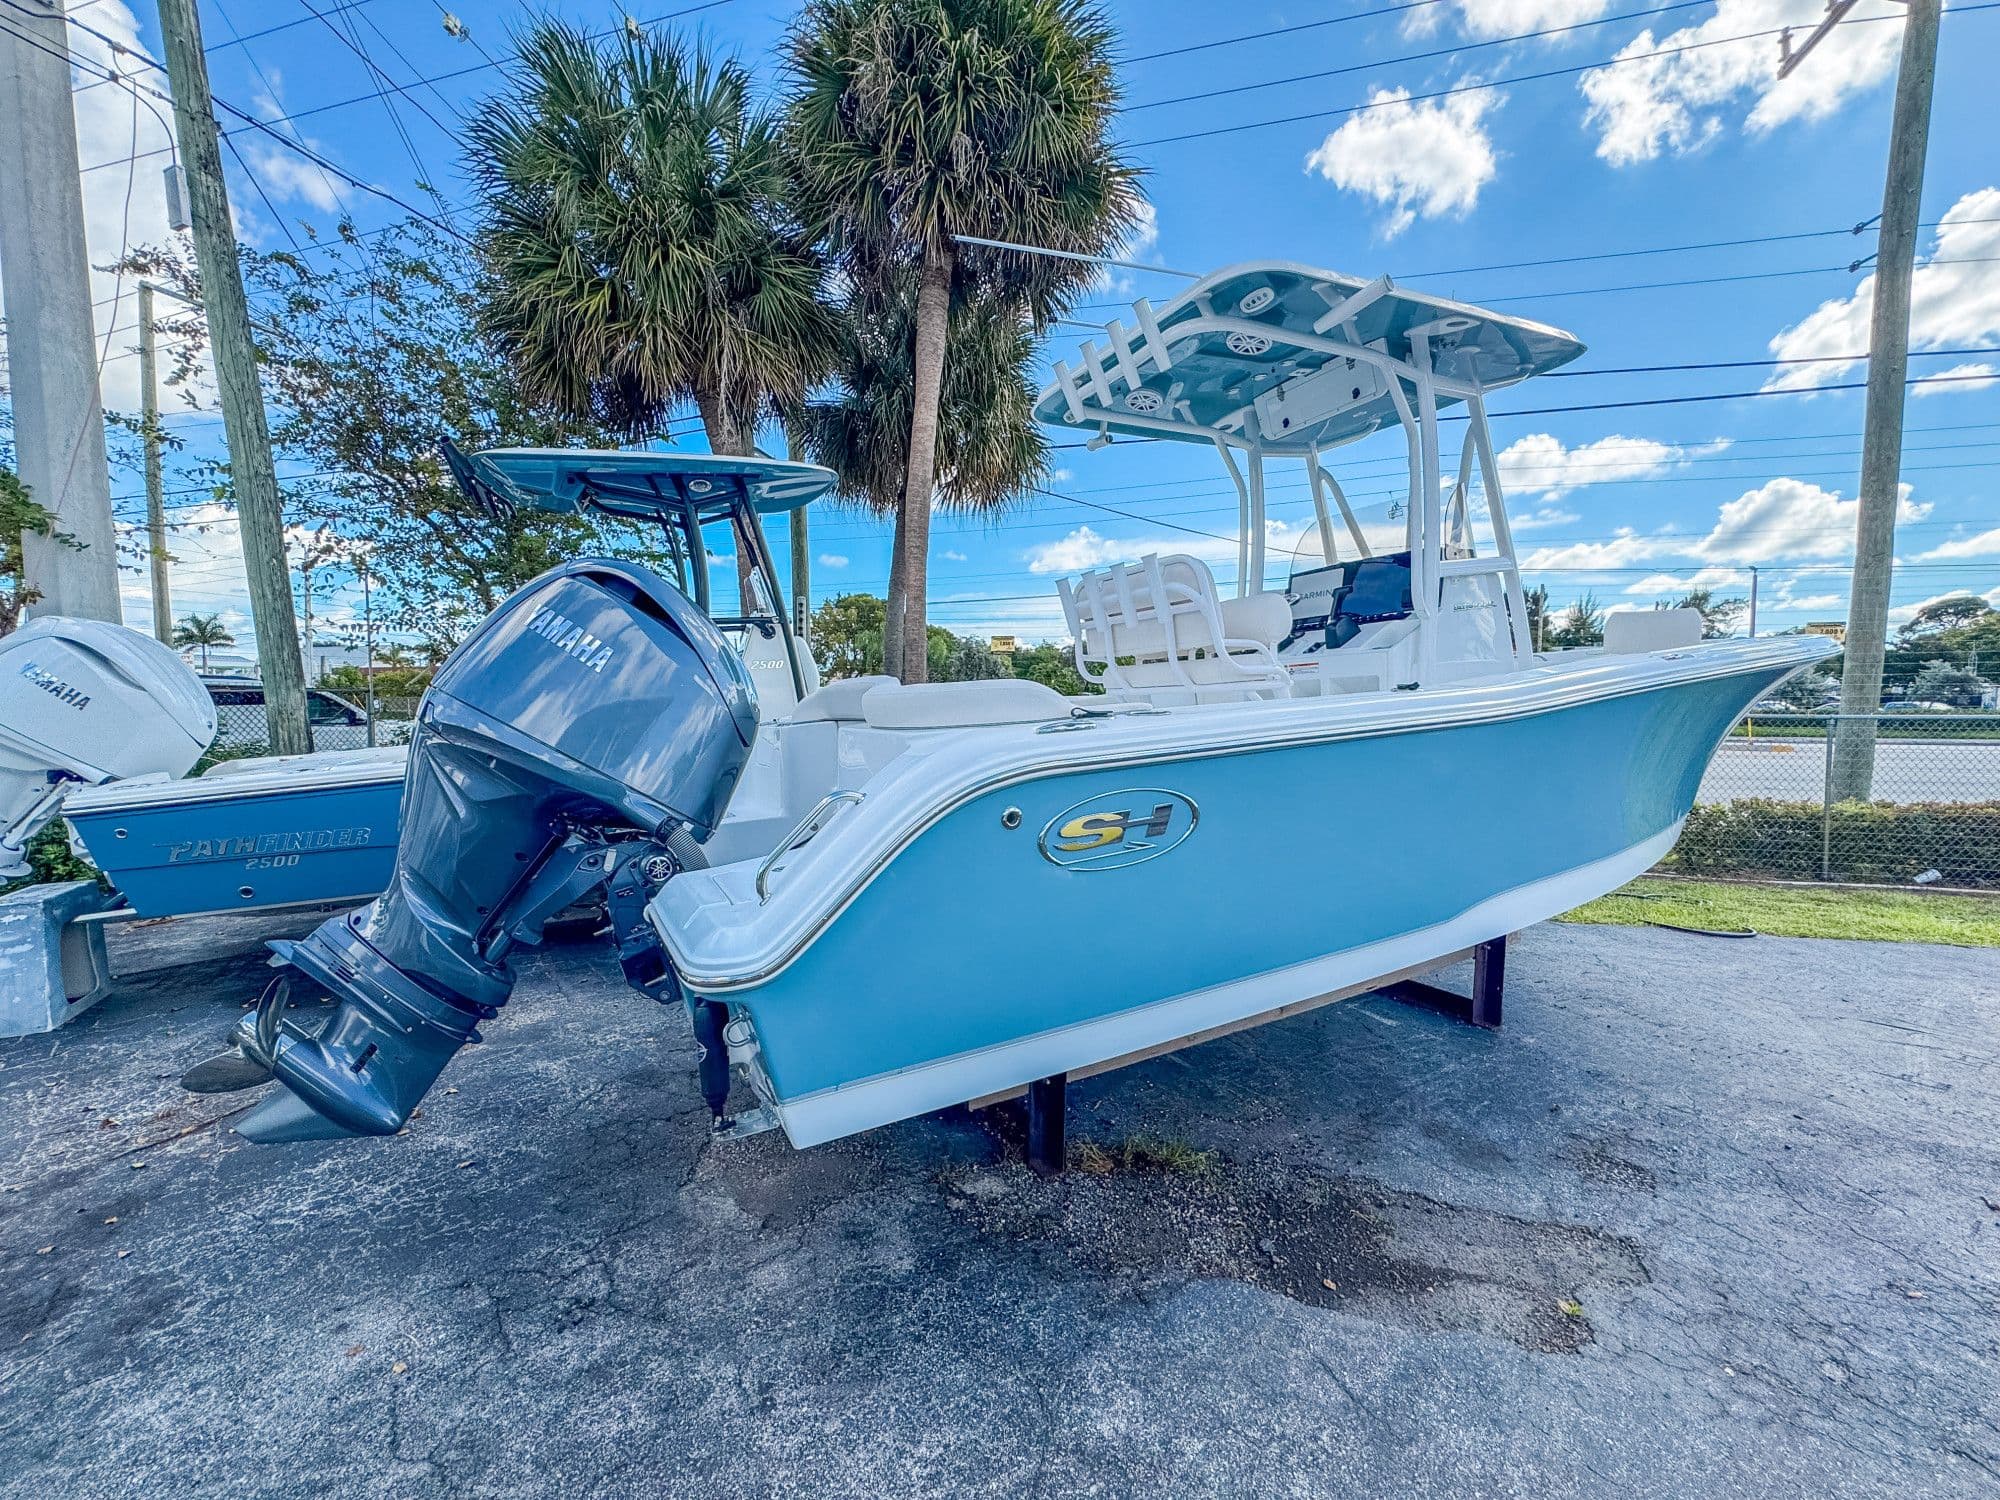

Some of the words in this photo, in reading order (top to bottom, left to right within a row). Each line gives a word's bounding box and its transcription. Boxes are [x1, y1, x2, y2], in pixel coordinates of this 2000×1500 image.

[523, 603, 615, 673] YAMAHA
[20, 660, 91, 711] YAMAHA
[750, 659, 784, 670] 2500
[152, 827, 372, 864] PATHFINDER
[1053, 802, 1174, 852] SH
[245, 854, 301, 870] 2500
